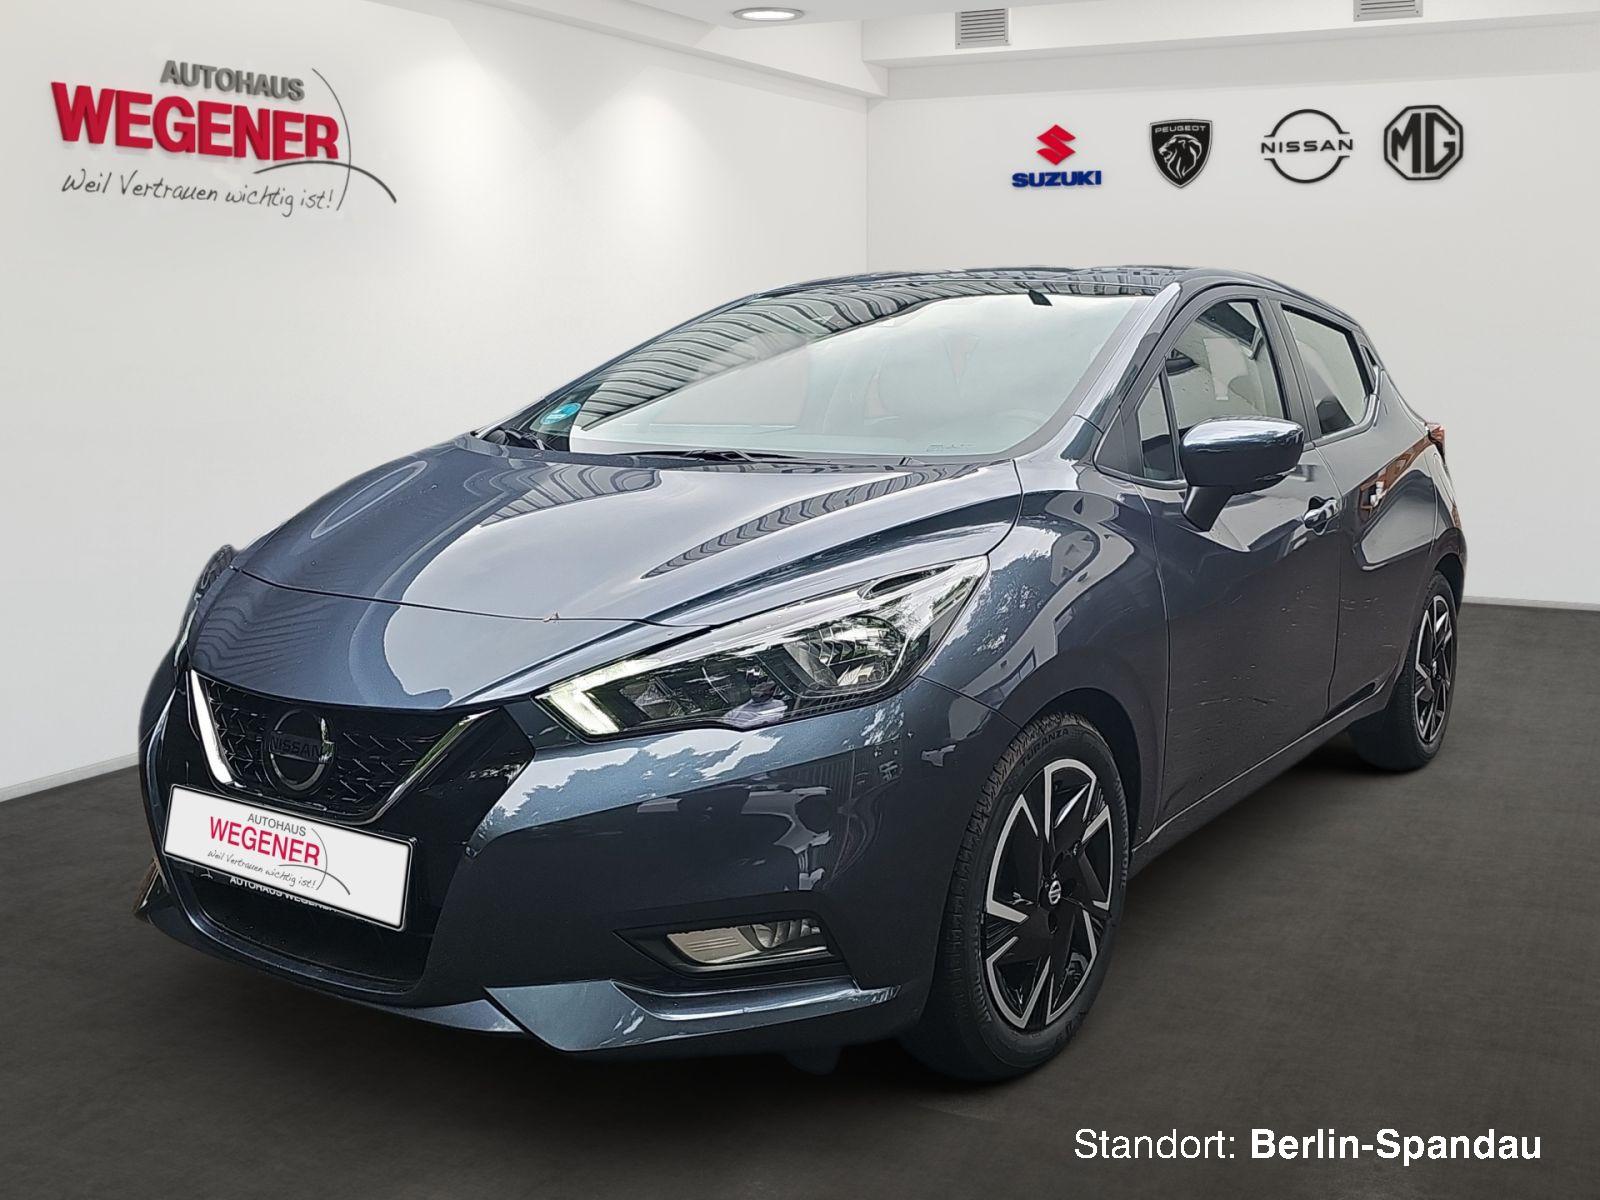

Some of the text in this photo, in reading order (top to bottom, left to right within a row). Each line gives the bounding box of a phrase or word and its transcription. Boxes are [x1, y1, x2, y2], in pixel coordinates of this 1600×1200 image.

[160, 60, 304, 101] AUTOHAUS
[51, 82, 339, 161] WEGENER
[1154, 124, 1206, 134] PEUGEOT
[1261, 138, 1354, 154] NISSAN
[1391, 112, 1456, 174] MG
[61, 168, 334, 217] Weil Vertrauen wichtig ist!
[1012, 170, 1102, 188] SUZUKI
[210, 816, 320, 866] WEGENER
[247, 813, 307, 837] AUTOHAUS
[207, 850, 316, 889] Weil Vertrauen wichtig ist!
